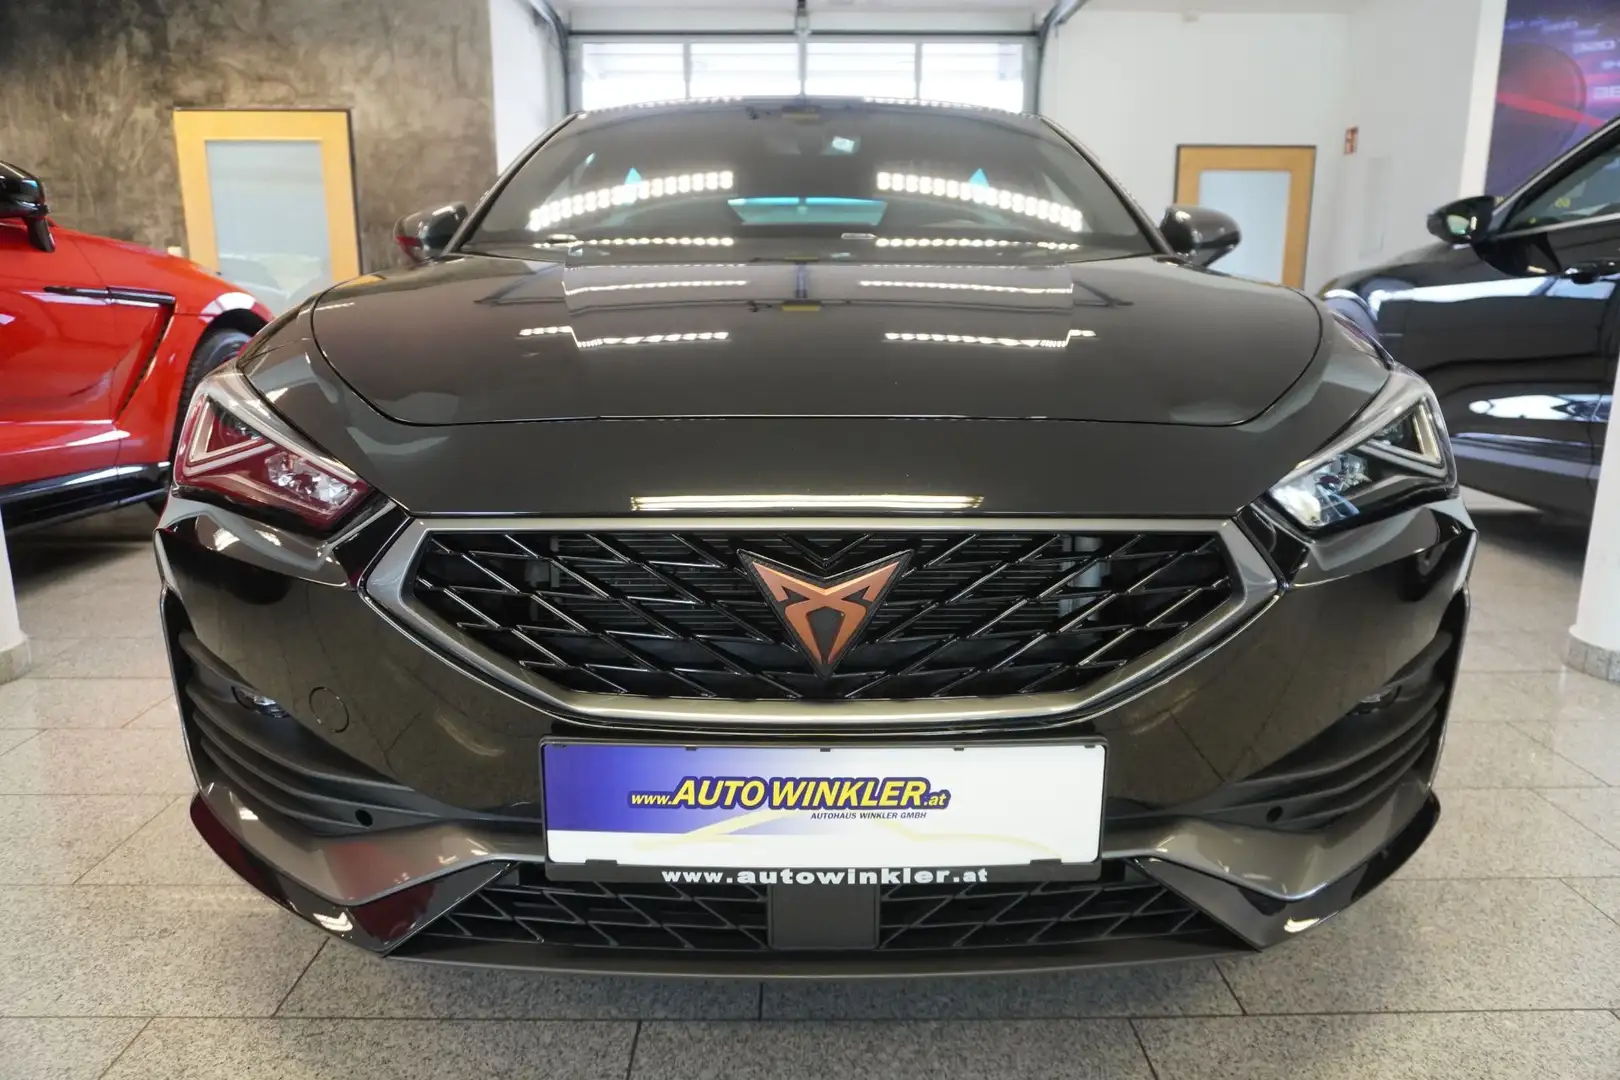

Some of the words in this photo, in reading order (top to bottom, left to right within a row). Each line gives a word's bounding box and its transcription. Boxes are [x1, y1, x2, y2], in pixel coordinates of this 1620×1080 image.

[810, 812, 857, 820] AUTOHAUS
[859, 812, 898, 820] WINKLER
[900, 811, 927, 820] GMBH
[661, 867, 988, 885] www.autowinkler.at
